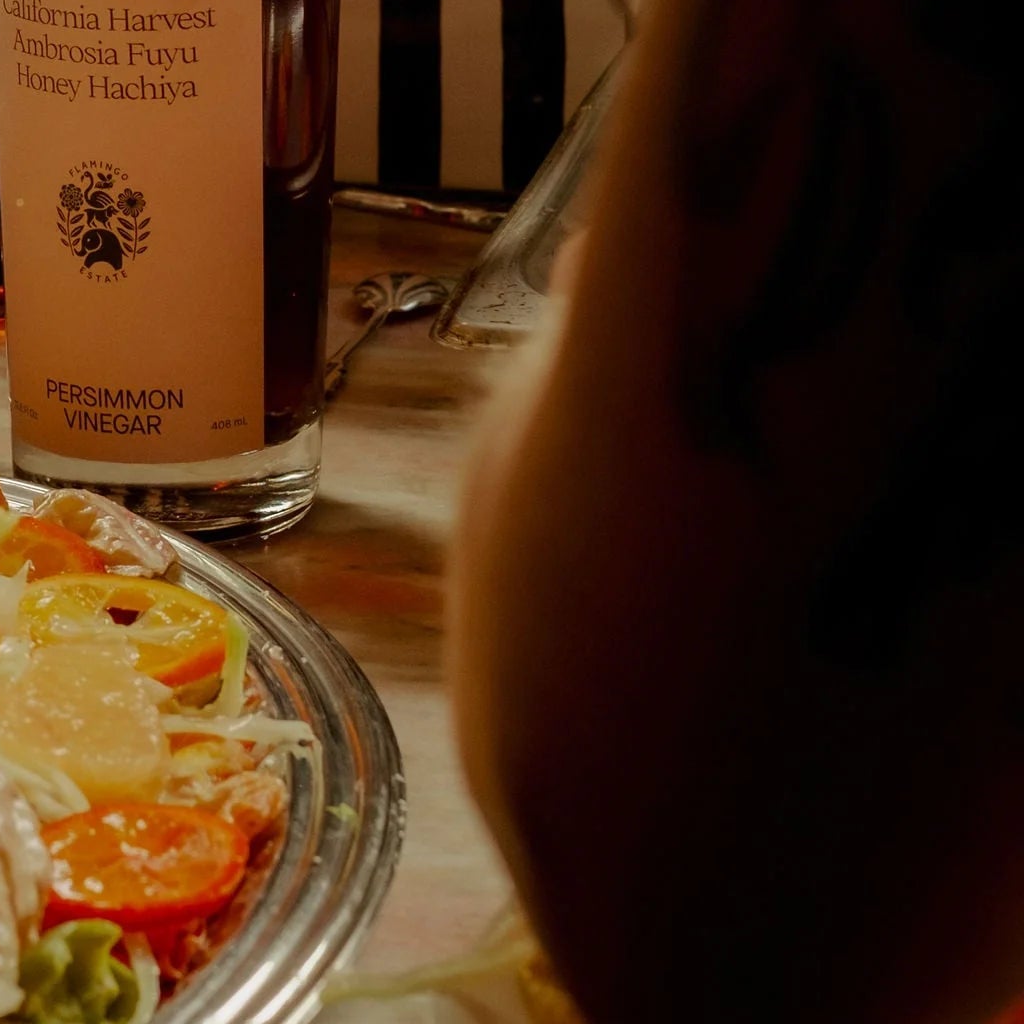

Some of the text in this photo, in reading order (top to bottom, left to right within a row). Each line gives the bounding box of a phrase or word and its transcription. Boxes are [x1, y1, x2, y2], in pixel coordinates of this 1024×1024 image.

[107, 7, 216, 32] Harvest
[13, 28, 200, 71] Ambrosia Fuyu
[16, 62, 198, 105] Honey Hachiya
[68, 160, 129, 181] FLAMINGO
[79, 266, 128, 283] ESTATE
[45, 379, 184, 410] PERSIMMON
[63, 408, 162, 435] VINEGAR
[211, 419, 232, 430] 408
